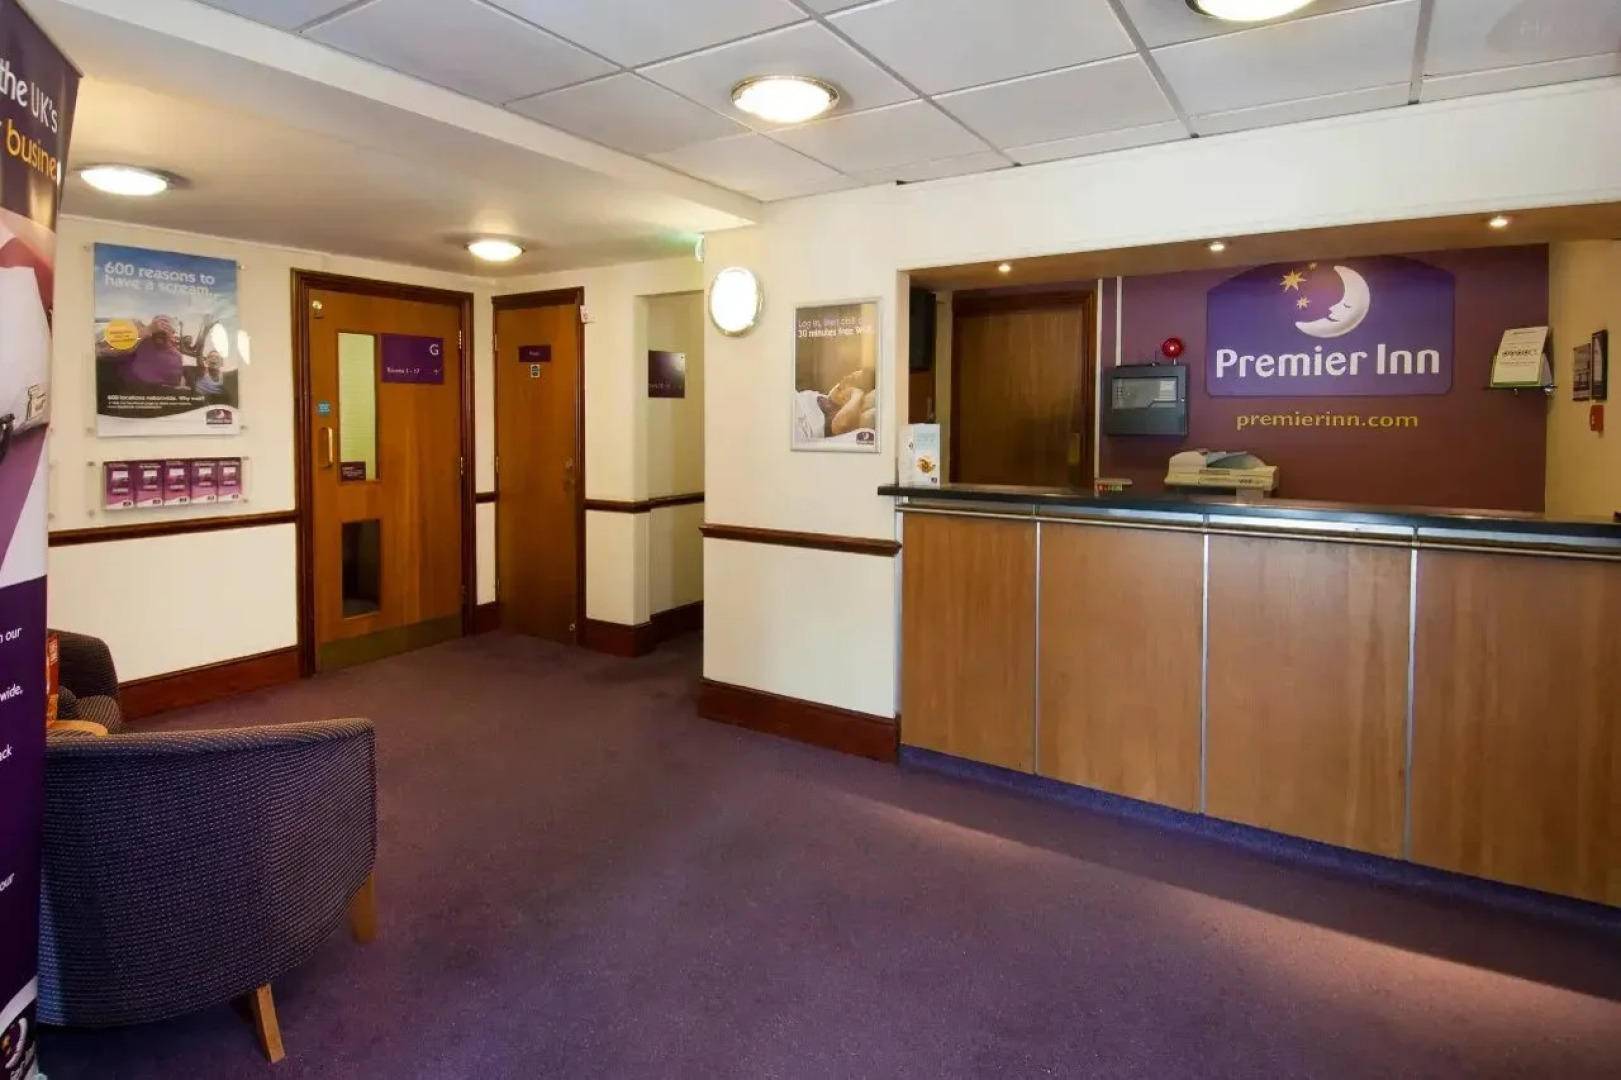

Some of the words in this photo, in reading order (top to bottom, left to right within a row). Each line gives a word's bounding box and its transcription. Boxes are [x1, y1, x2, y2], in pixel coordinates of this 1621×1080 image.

[31, 82, 58, 133] UK's
[104, 261, 134, 277] 600
[138, 266, 196, 284] reasons
[200, 273, 216, 286] to
[104, 275, 140, 290] have
[144, 281, 154, 291] a
[798, 329, 808, 339] 30
[808, 327, 837, 338] minutes
[429, 344, 439, 355] G
[1216, 345, 1368, 379] Premier
[1376, 343, 1440, 375] Inn
[1236, 411, 1419, 431] premierinn.com
[5, 627, 23, 642] our
